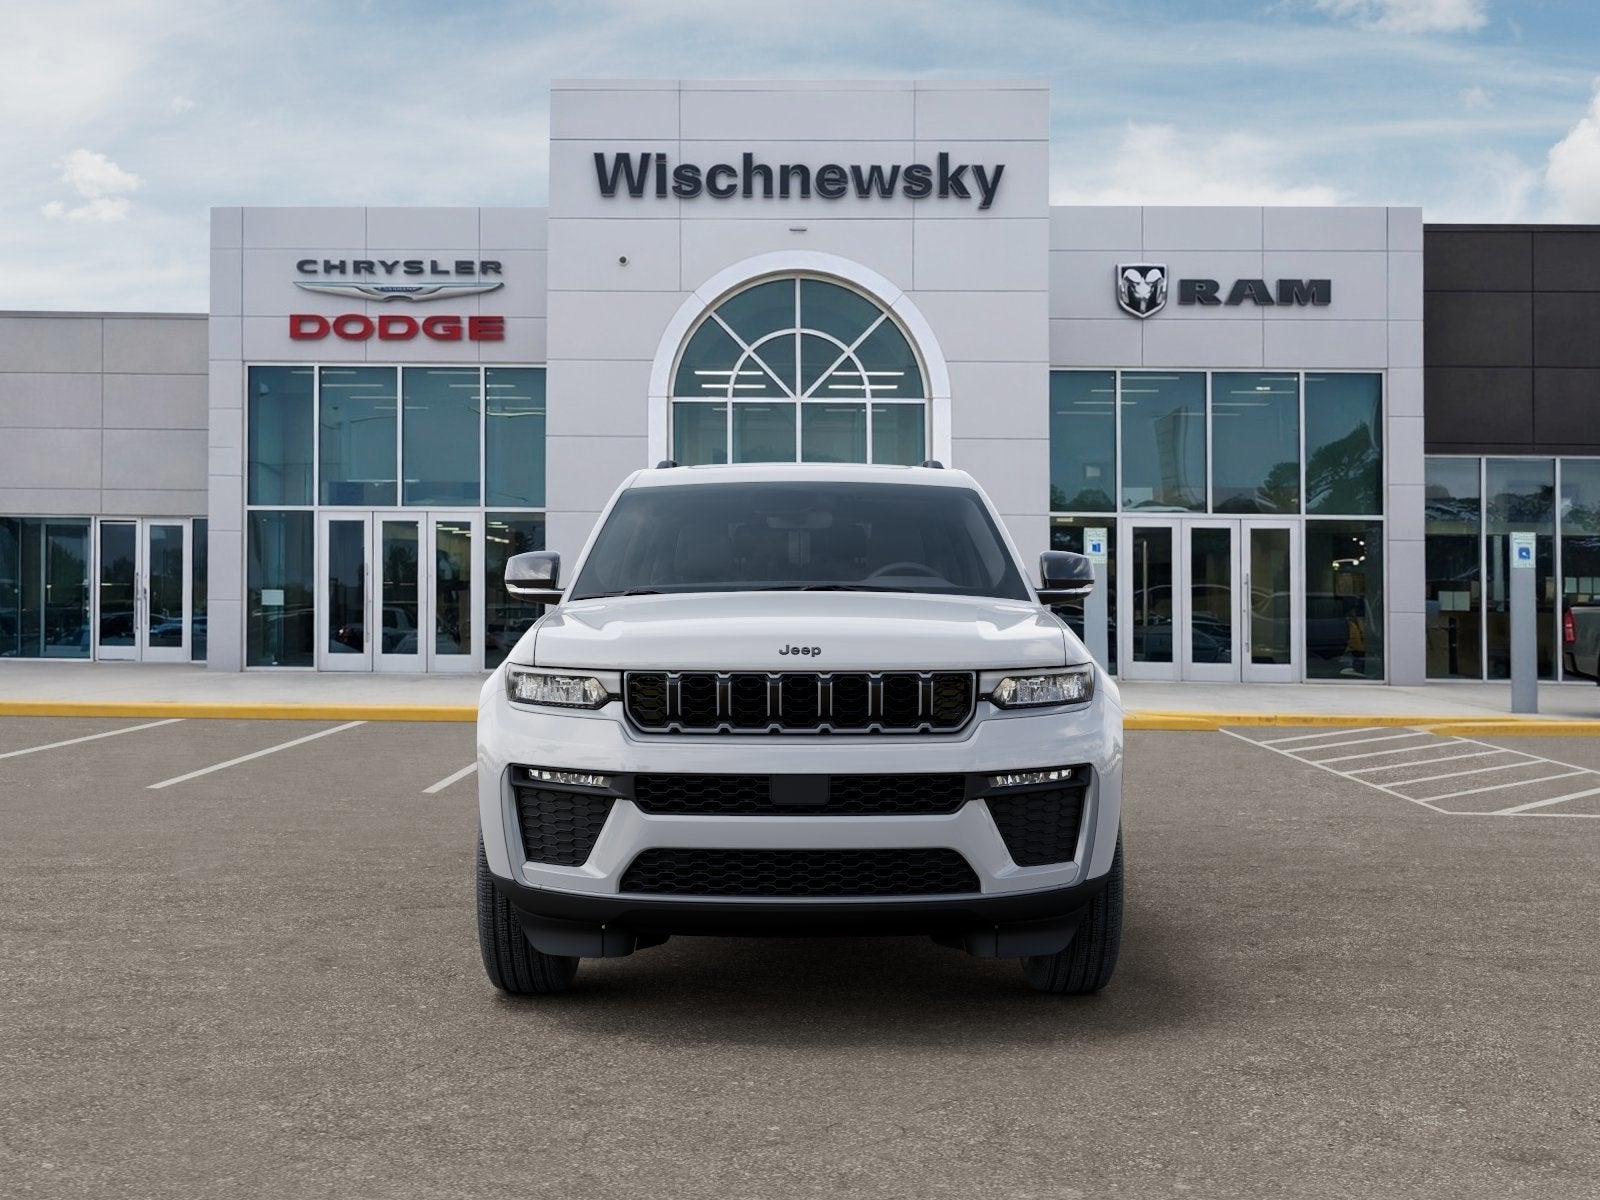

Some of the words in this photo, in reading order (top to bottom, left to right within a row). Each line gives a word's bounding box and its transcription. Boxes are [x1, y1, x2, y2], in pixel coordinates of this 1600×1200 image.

[593, 152, 1006, 210] Wischnewsky
[296, 259, 503, 275] CHRYSLER
[1177, 279, 1332, 306] RAM
[289, 314, 505, 342] DODGE
[778, 644, 822, 658] Jeep
